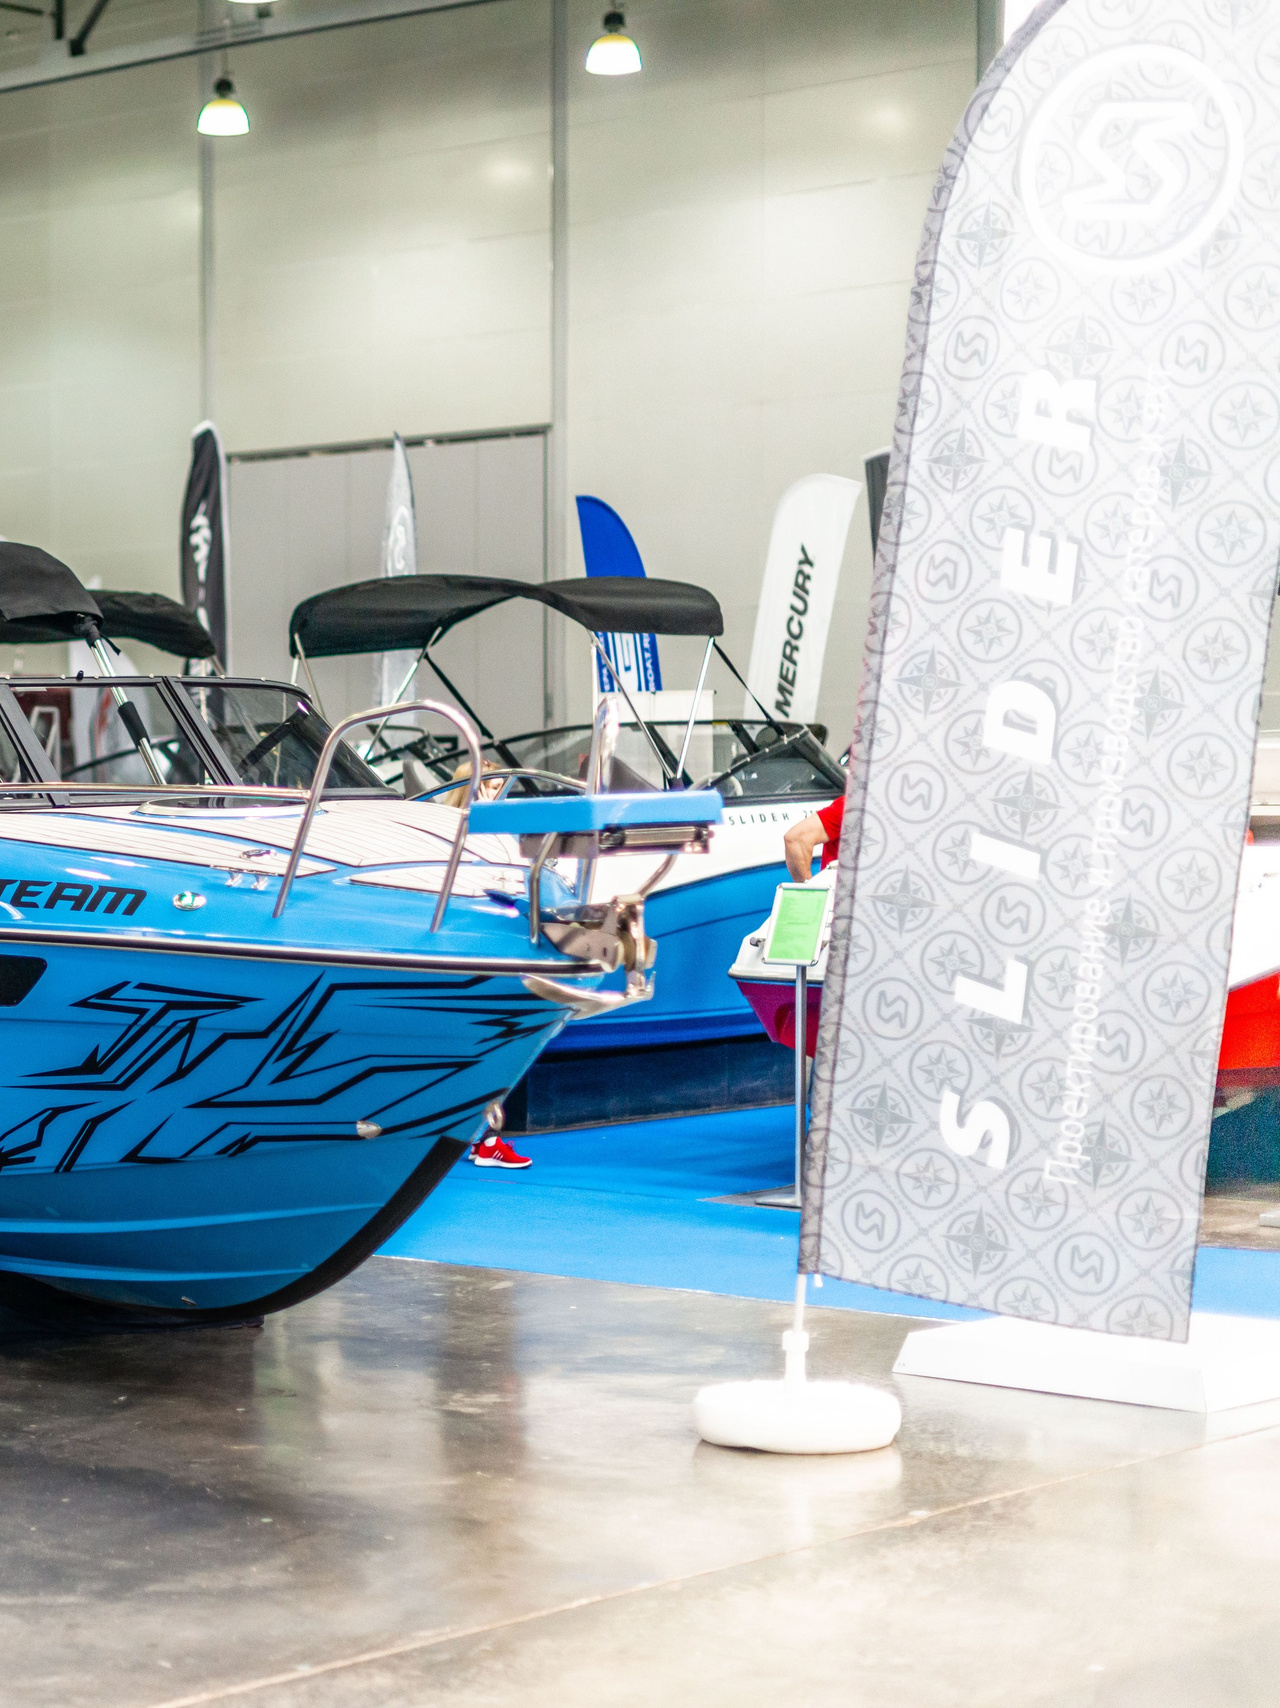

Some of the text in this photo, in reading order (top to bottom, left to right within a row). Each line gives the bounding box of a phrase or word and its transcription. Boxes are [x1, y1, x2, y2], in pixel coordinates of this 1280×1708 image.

[1121, 465, 1163, 603] катеров
[775, 543, 814, 718] MERCURY
[728, 807, 790, 826] SLIDER
[939, 369, 1097, 1169] SLIDER
[1094, 615, 1144, 855] производство
[1090, 866, 1113, 887] и
[1044, 898, 1111, 1186] Проектирование
